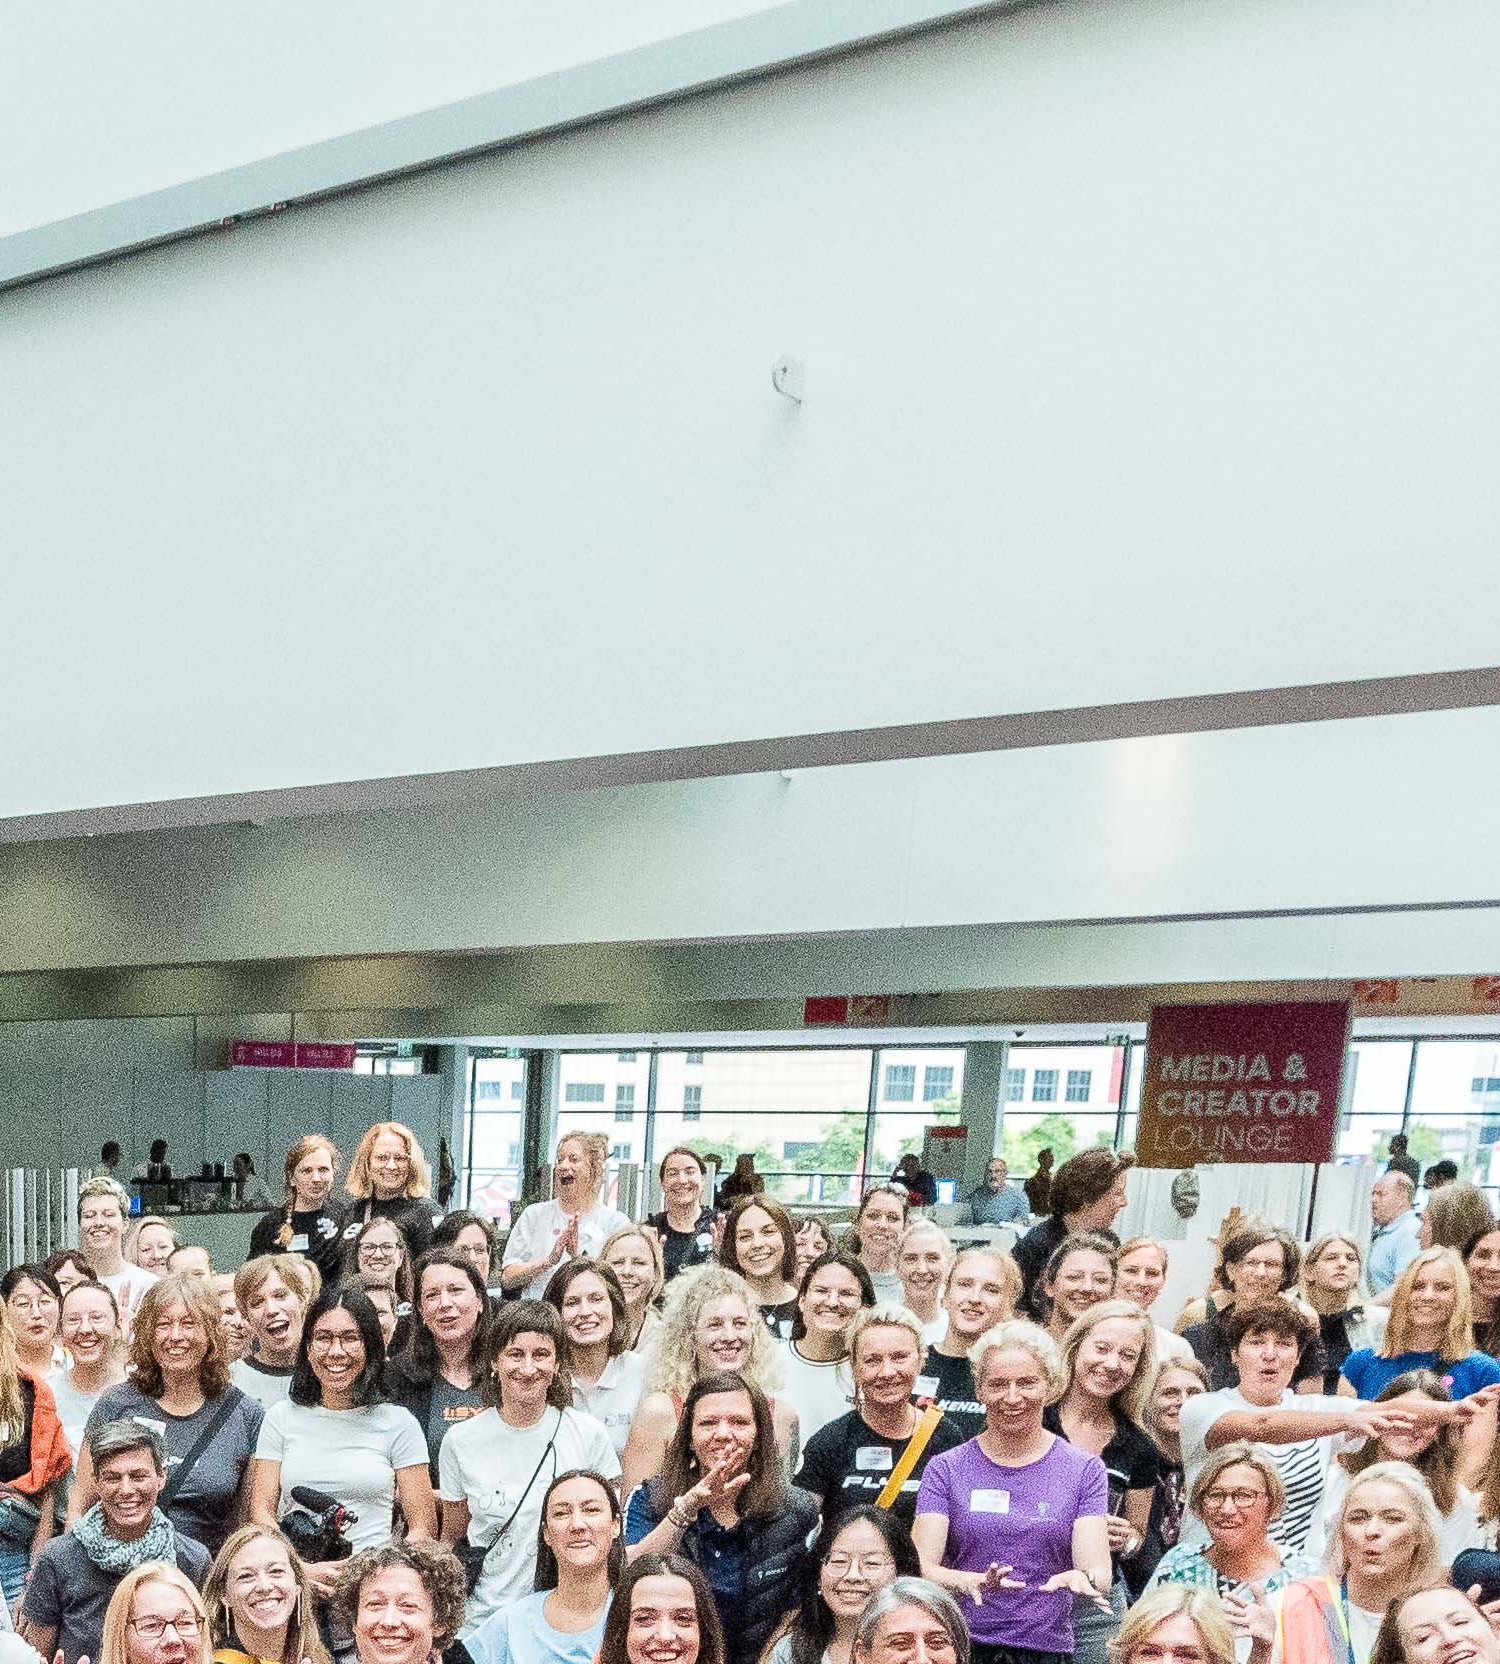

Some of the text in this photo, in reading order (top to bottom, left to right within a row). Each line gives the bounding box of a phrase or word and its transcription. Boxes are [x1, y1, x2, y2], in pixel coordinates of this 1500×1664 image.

[1159, 1053, 1308, 1082] MEDIA &
[1156, 1089, 1321, 1117] CREATOR
[1153, 1124, 1295, 1152] LOUNGE
[938, 1398, 987, 1414] KENDA
